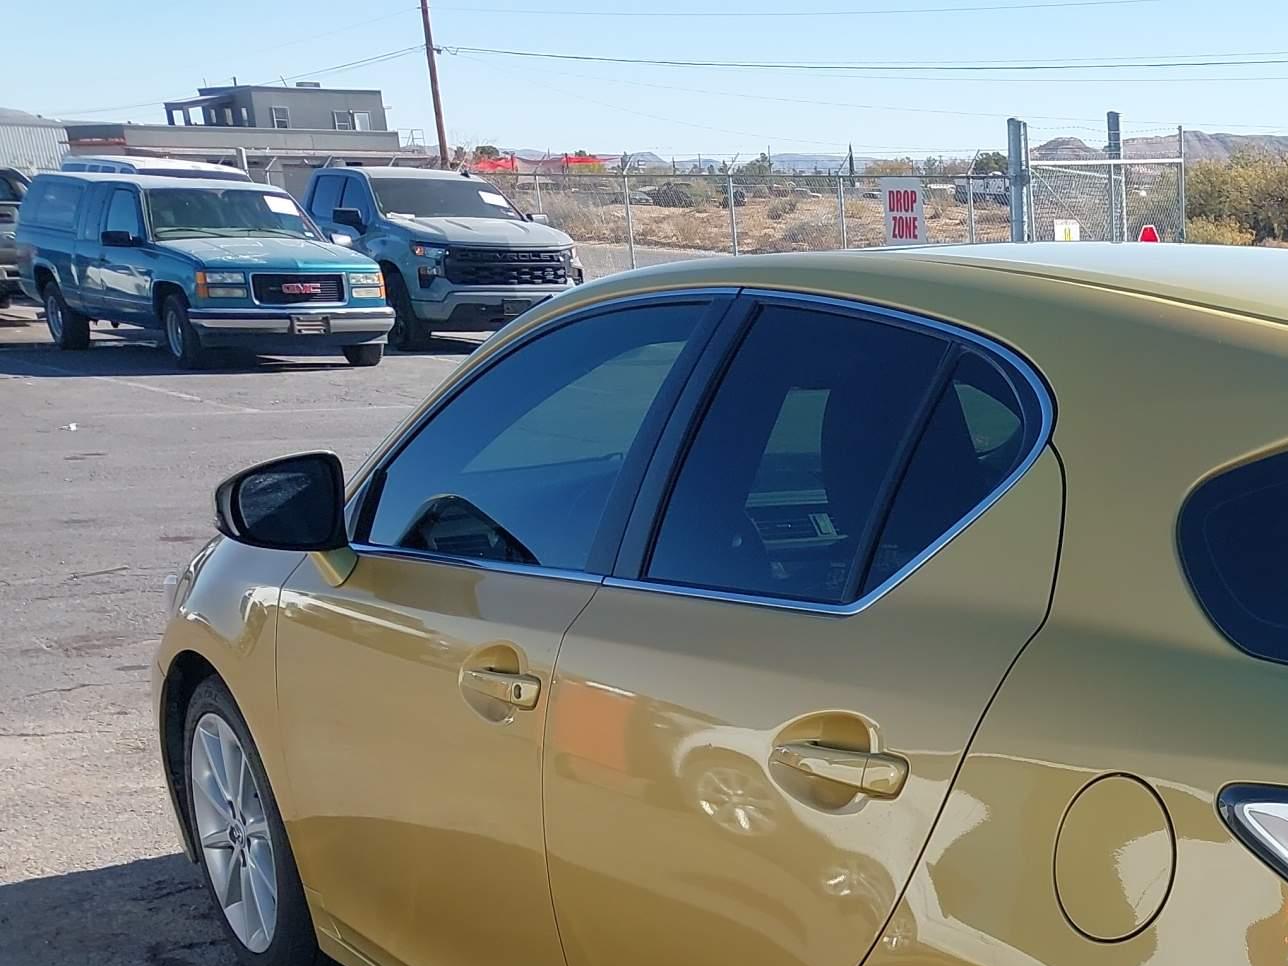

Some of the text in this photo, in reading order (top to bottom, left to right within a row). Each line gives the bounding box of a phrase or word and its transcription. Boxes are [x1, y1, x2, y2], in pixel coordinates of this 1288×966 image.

[888, 190, 917, 213] DROP
[892, 216, 918, 240] ZONE
[282, 283, 321, 294] GMC
